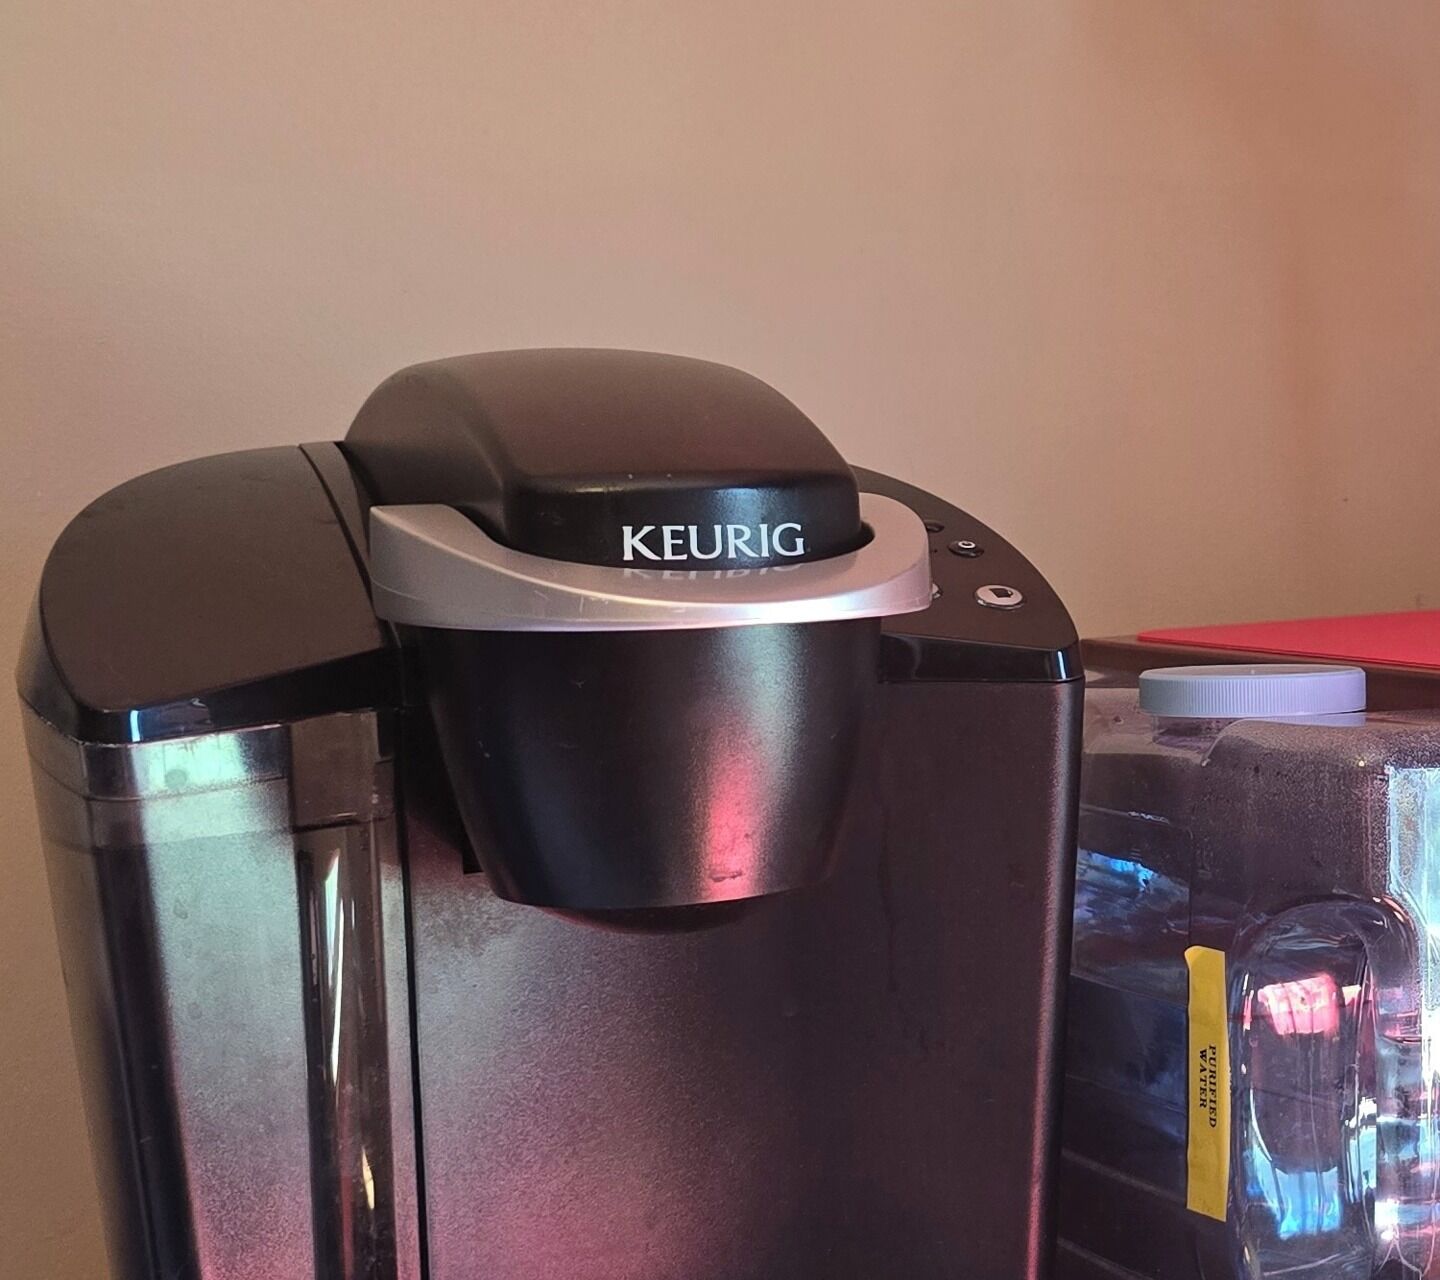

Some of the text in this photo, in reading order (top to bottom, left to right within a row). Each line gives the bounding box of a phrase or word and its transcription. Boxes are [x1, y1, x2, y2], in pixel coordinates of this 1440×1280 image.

[621, 522, 806, 562] KEURIG
[1199, 1048, 1208, 1109] WATER
[1207, 1045, 1218, 1129] PURIFIED
